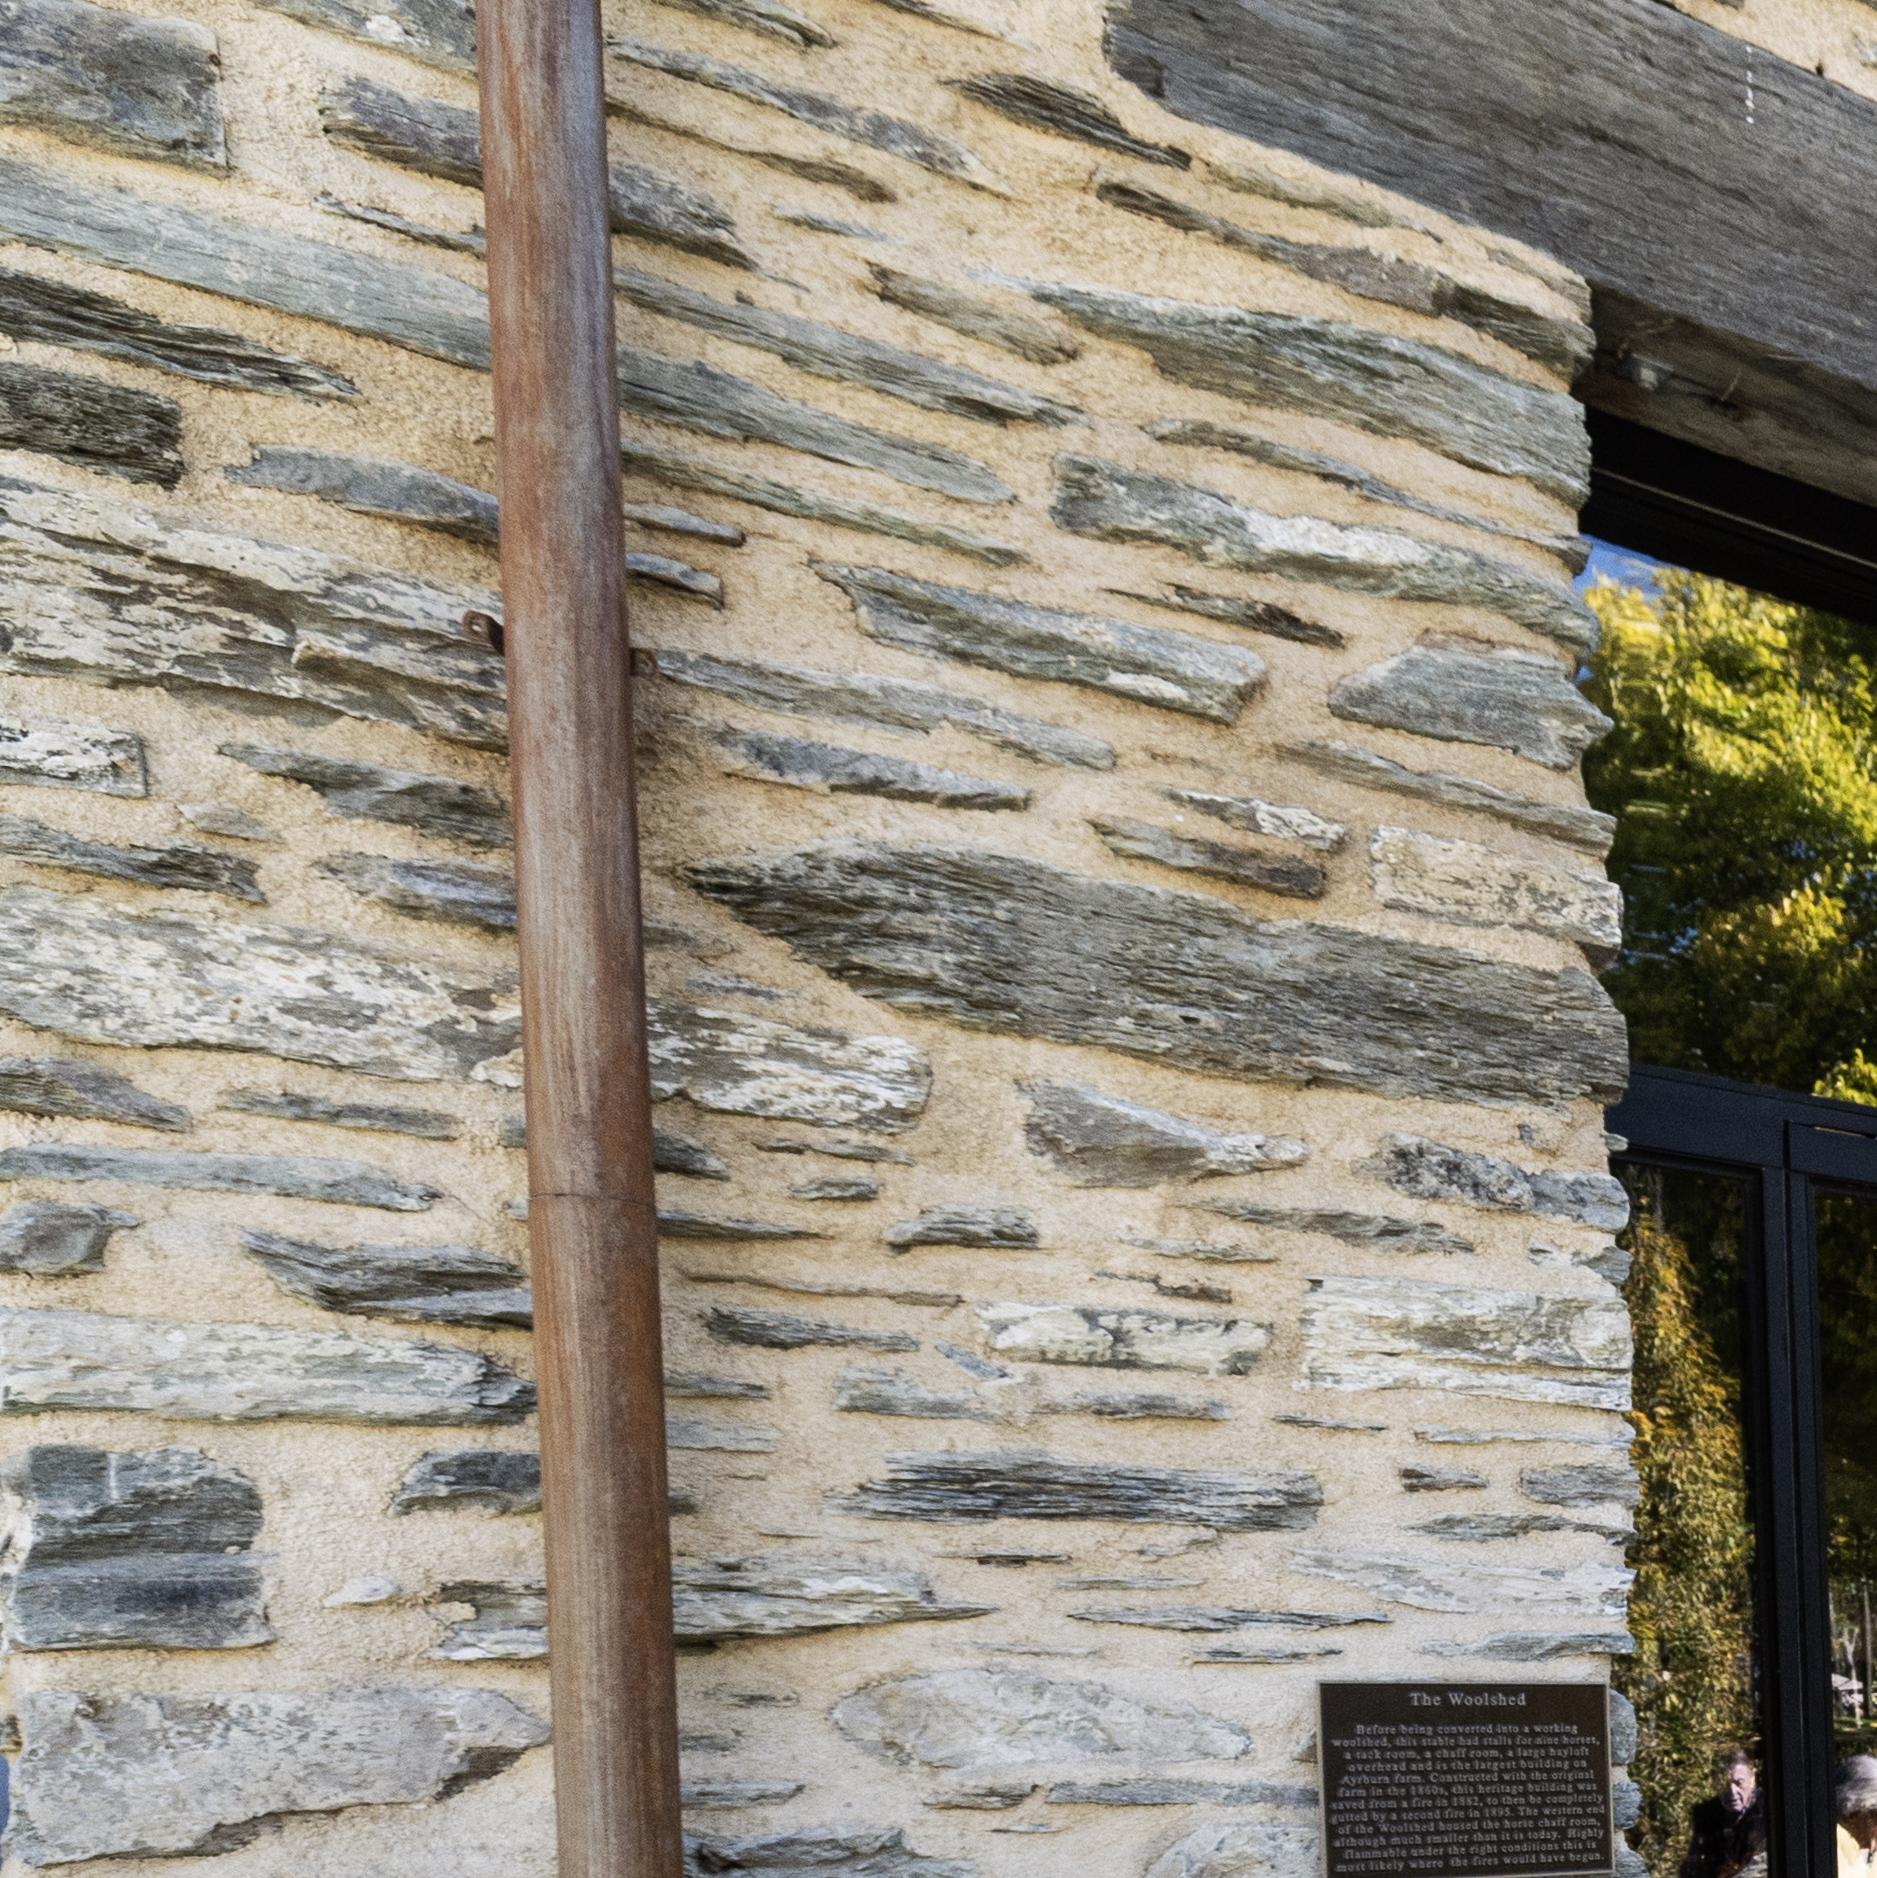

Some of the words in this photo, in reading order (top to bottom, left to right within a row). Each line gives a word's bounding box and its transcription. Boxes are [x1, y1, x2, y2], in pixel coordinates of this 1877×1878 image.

[1409, 1692, 1441, 1706] The
[1447, 1691, 1526, 1706] Woolshed
[1356, 1725, 1396, 1735] Before
[1400, 1724, 1433, 1736] being
[1437, 1725, 1493, 1734] converted
[1496, 1724, 1519, 1734] into
[1533, 1724, 1578, 1734] working
[1332, 1737, 1392, 1748] woolshed,
[1395, 1737, 1417, 1746] this
[1420, 1737, 1455, 1746] stable
[1457, 1736, 1479, 1746] had
[1483, 1736, 1512, 1745] stalls
[1515, 1736, 1532, 1745] for
[1561, 1736, 1600, 1746] horses,
[1356, 1750, 1381, 1759] tack
[1386, 1751, 1421, 1759] room,
[1435, 1748, 1467, 1758] chaff
[1469, 1749, 1503, 1758] room,
[1518, 1748, 1546, 1758] large
[1549, 1747, 1589, 1758] hayloft
[1348, 1762, 1406, 1772] overhead
[1410, 1761, 1433, 1771] and
[1436, 1761, 1448, 1770] is
[1450, 1761, 1471, 1770] the
[1475, 1760, 1517, 1771] largest
[1520, 1759, 1570, 1770] building
[1573, 1760, 1587, 1768] on
[1429, 1772, 1498, 1783] Constructed
[1502, 1772, 1527, 1780] with
[1530, 1771, 1547, 1780] the
[1551, 1770, 1594, 1781] original
[1337, 1787, 1366, 1798] farm
[1371, 1787, 1383, 1796] in
[1387, 1786, 1406, 1796] the
[1411, 1785, 1449, 1795] 1860s,
[1450, 1785, 1474, 1794] this
[1478, 1784, 1524, 1795] heritage
[1527, 1783, 1574, 1793] building
[1577, 1783, 1597, 1791] was
[1331, 1800, 1365, 1810] saved
[1368, 1799, 1397, 1809] from
[1412, 1798, 1433, 1807] fire
[1435, 1799, 1448, 1807] in
[1451, 1796, 1483, 1807] 1882,
[1486, 1797, 1498, 1805] to
[1502, 1796, 1525, 1805] then
[1529, 1795, 1542, 1804] be
[1545, 1794, 1604, 1805] completely
[1330, 1812, 1368, 1825] gutted
[1372, 1812, 1386, 1823] by
[1401, 1810, 1440, 1819] second
[1444, 1808, 1465, 1818] fire
[1469, 1809, 1480, 1818] in
[1485, 1808, 1514, 1817] 1895.
[1518, 1806, 1539, 1816] The
[1541, 1806, 1583, 1815] western
[1586, 1805, 1605, 1814] end
[1338, 1825, 1352, 1835] of
[1355, 1824, 1374, 1834] the
[1377, 1822, 1435, 1833] Woolshed
[1438, 1821, 1479, 1831] housed
[1482, 1820, 1500, 1829] the
[1503, 1819, 1534, 1828] horse
[1538, 1817, 1567, 1828] chaff
[1570, 1818, 1601, 1827] room,
[1334, 1837, 1386, 1848] although
[1390, 1835, 1422, 1846] much
[1426, 1834, 1469, 1844] smaller
[1473, 1832, 1497, 1841] than
[1501, 1831, 1510, 1840] it
[1514, 1831, 1524, 1840] is
[1528, 1830, 1561, 1840] today.
[1567, 1828, 1604, 1839] Highly
[1344, 1849, 1407, 1859] flammable
[1410, 1847, 1444, 1857] under
[1447, 1846, 1466, 1855] the
[1469, 1844, 1498, 1856] right
[1501, 1841, 1559, 1853] conditions
[1562, 1841, 1583, 1850] this
[1586, 1840, 1597, 1849] is
[1336, 1863, 1366, 1873] most
[1368, 1861, 1404, 1872] likely
[1408, 1859, 1444, 1869] where
[1450, 1857, 1468, 1867] the
[1472, 1856, 1499, 1866] fires
[1502, 1854, 1536, 1864] would
[1540, 1853, 1565, 1863] have
[1568, 1853, 1604, 1863] begun.
